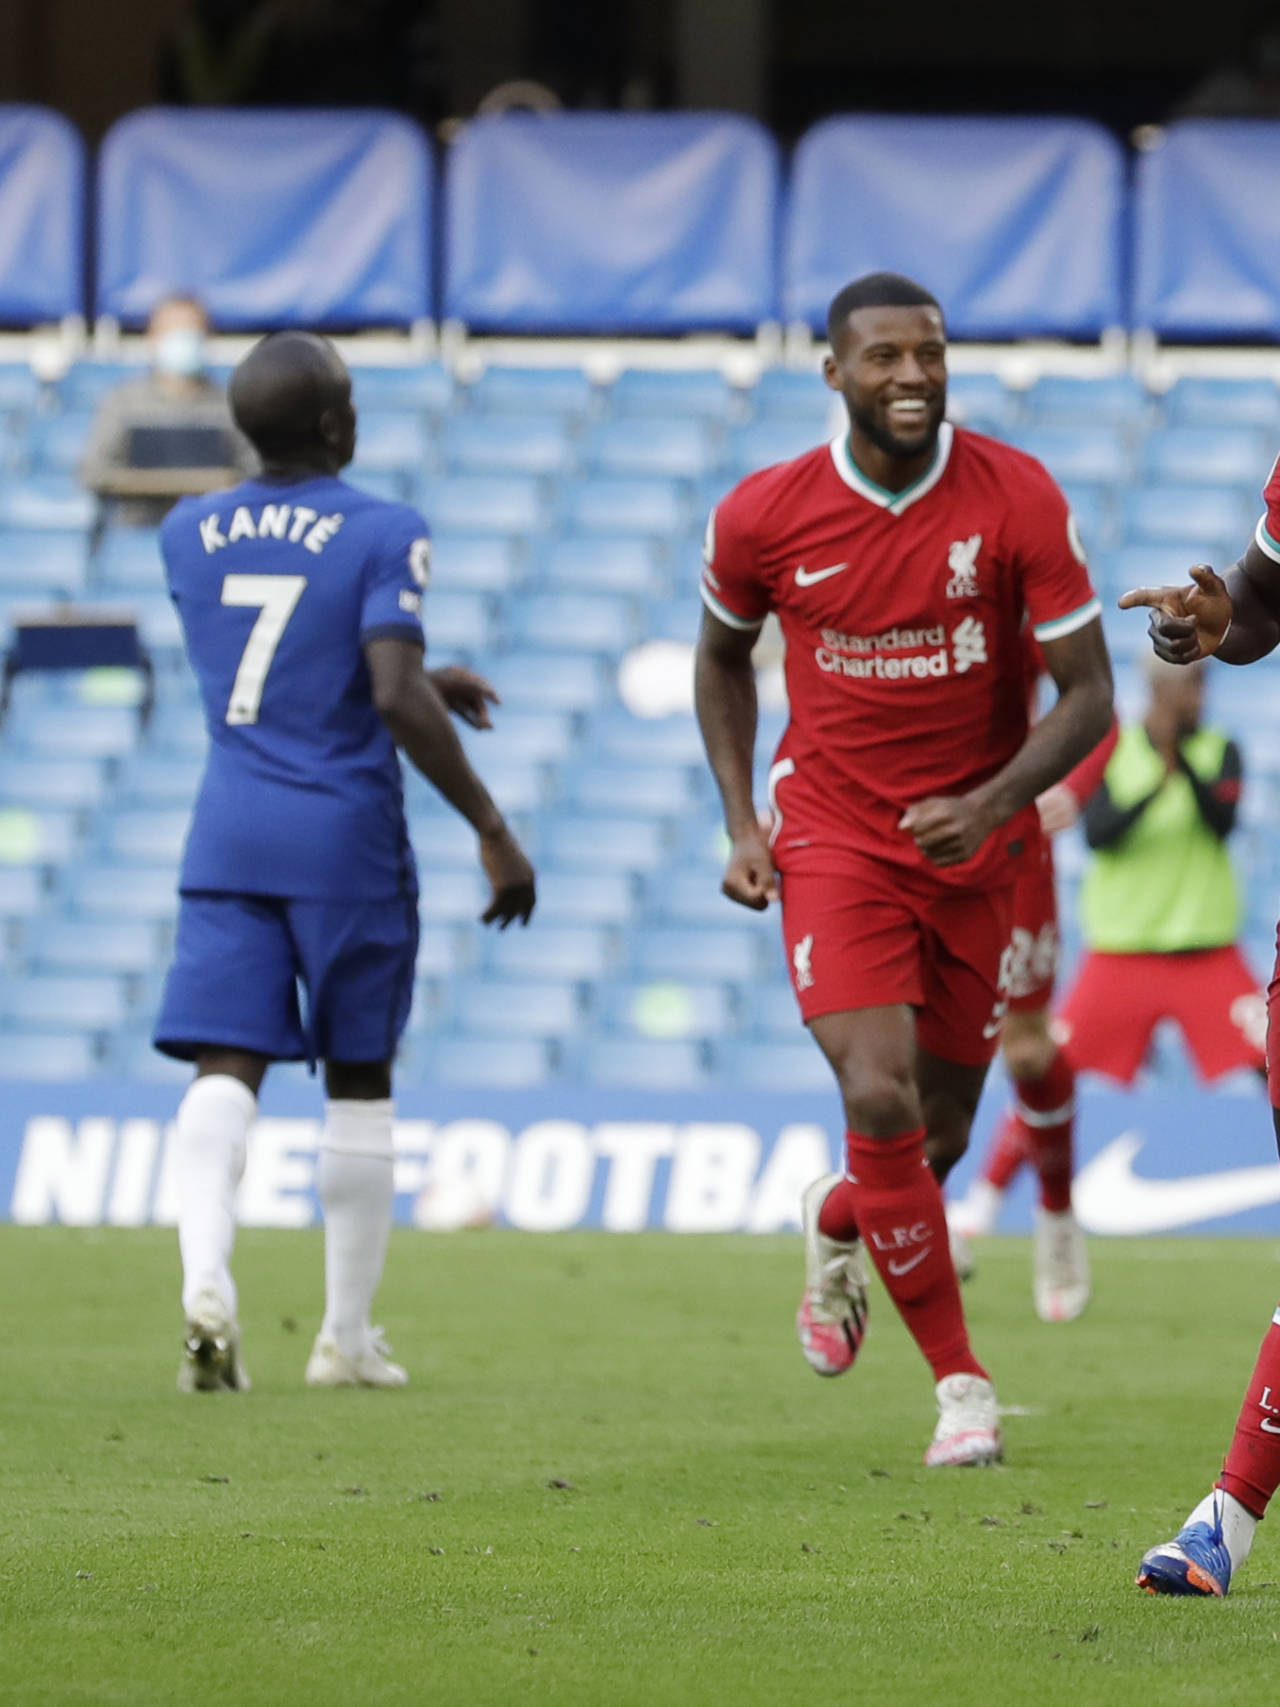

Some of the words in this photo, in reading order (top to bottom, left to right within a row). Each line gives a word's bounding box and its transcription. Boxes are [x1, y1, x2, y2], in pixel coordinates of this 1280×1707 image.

[200, 504, 344, 554] KANTÉ
[220, 573, 308, 726] 7
[820, 624, 946, 654] Standard
[815, 649, 948, 680] Chartered
[391, 1117, 832, 1234] OOTBA
